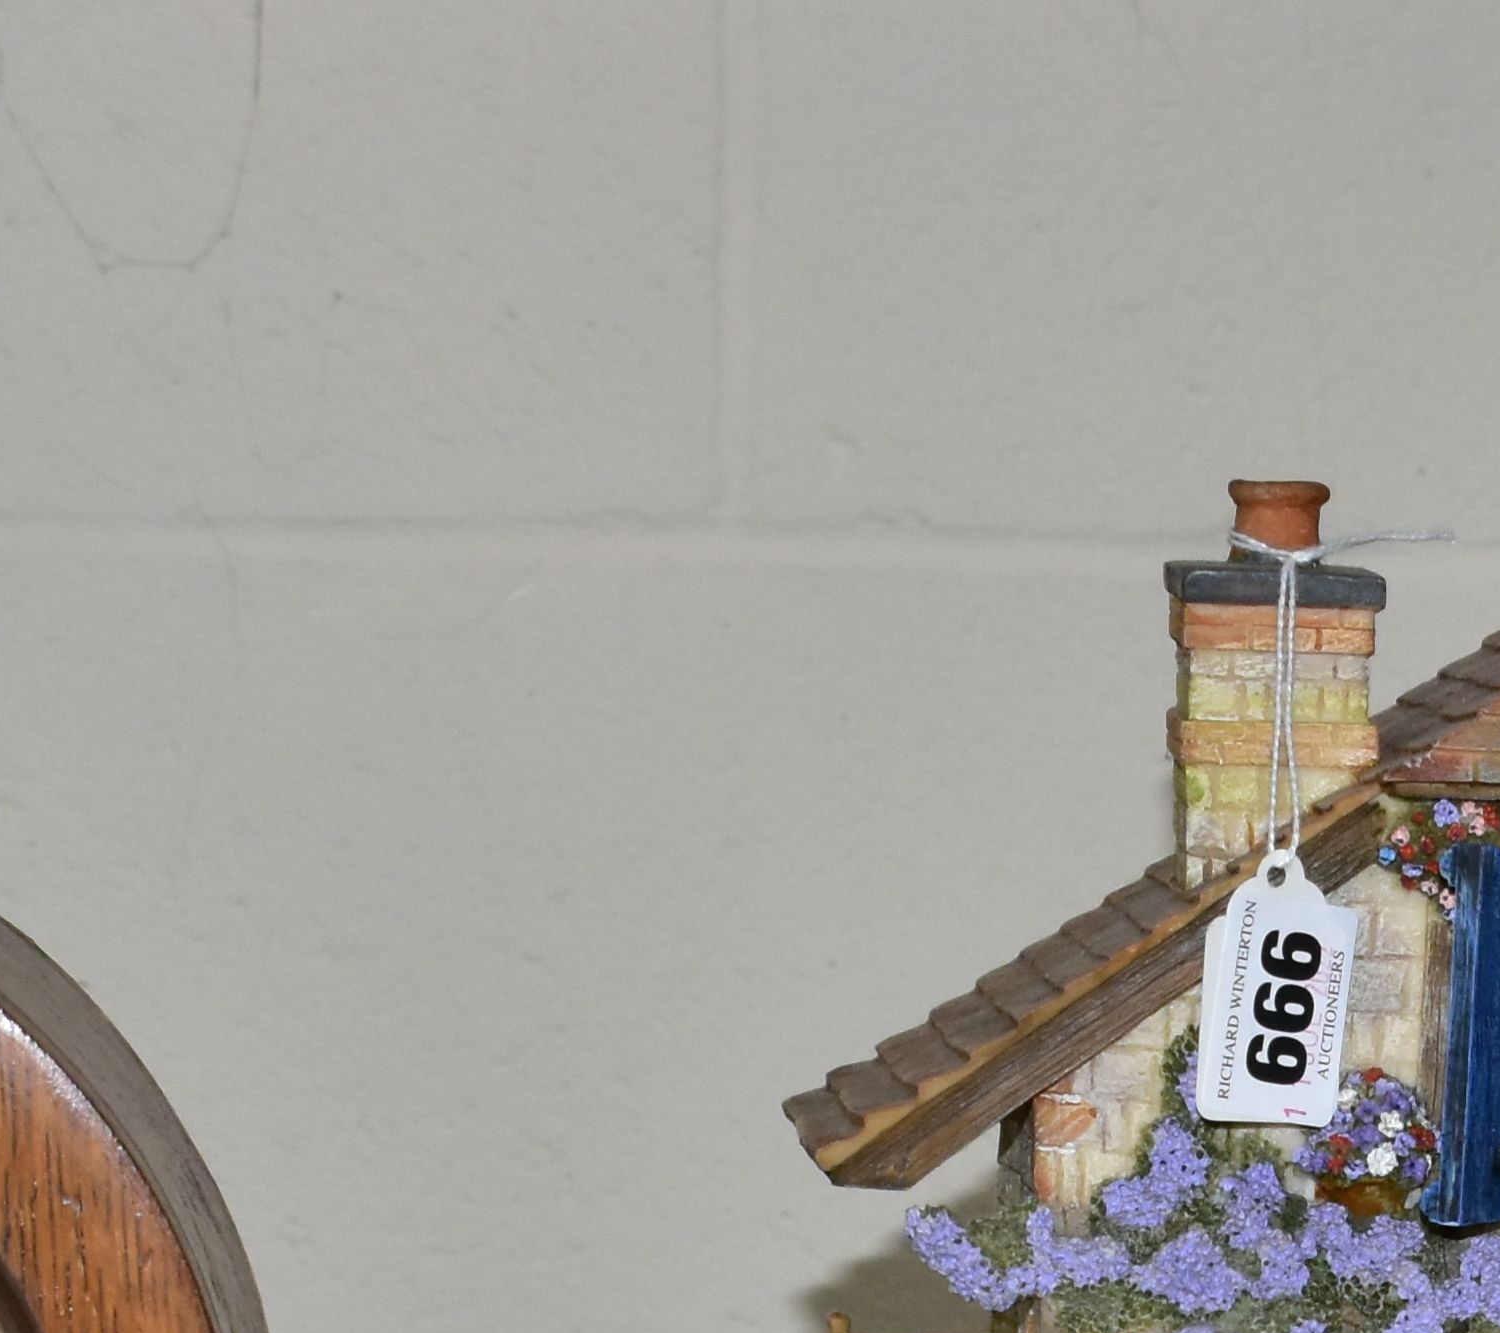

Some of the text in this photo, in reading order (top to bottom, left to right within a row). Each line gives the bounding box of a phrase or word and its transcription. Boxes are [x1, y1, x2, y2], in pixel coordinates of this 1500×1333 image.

[1217, 899, 1258, 1100] RICHARD WINTERTON
[1245, 929, 1322, 1086] 666
[1316, 949, 1346, 1081] AUCTIONEERS
